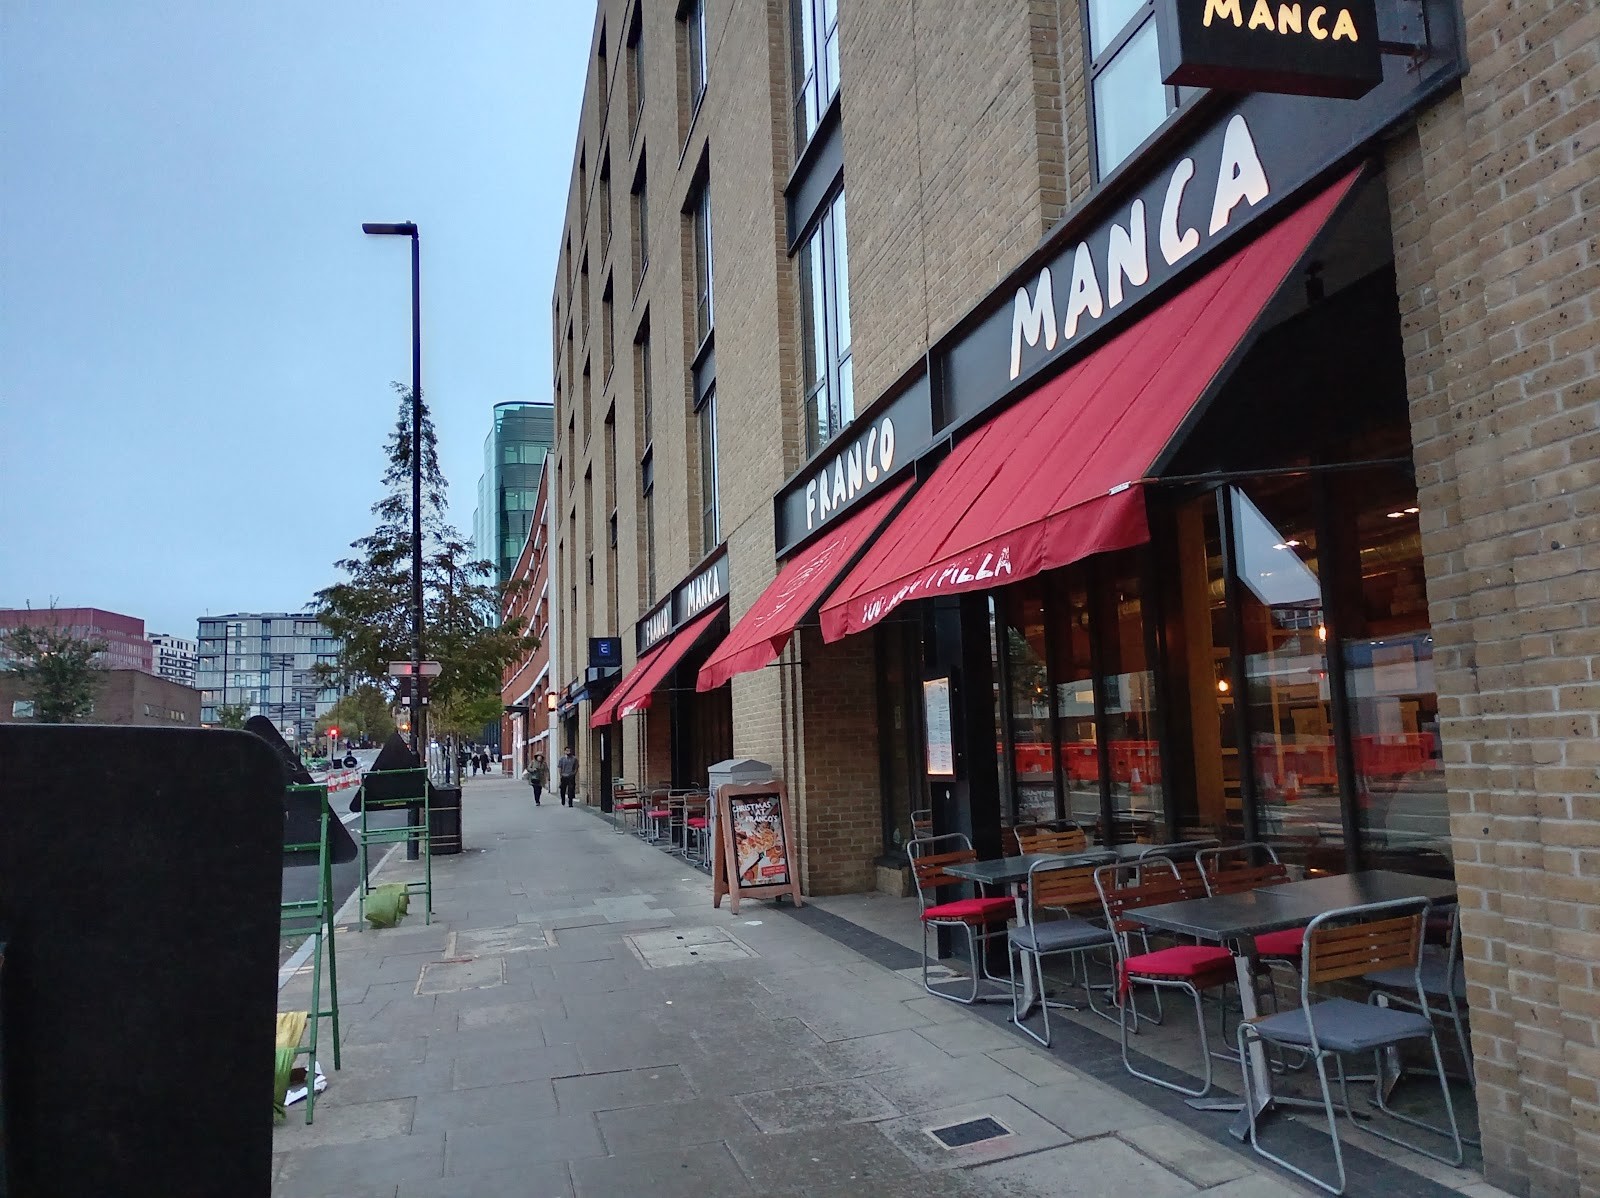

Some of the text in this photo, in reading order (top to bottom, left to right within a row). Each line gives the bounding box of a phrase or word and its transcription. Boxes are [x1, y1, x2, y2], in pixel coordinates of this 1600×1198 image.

[1202, 0, 1359, 42] MANCA
[806, 114, 1270, 530] FRANCO MANCA
[687, 565, 720, 617] MANCA
[732, 802, 770, 812] CHRISTMAS
[745, 815, 778, 823] FRANCO'S
